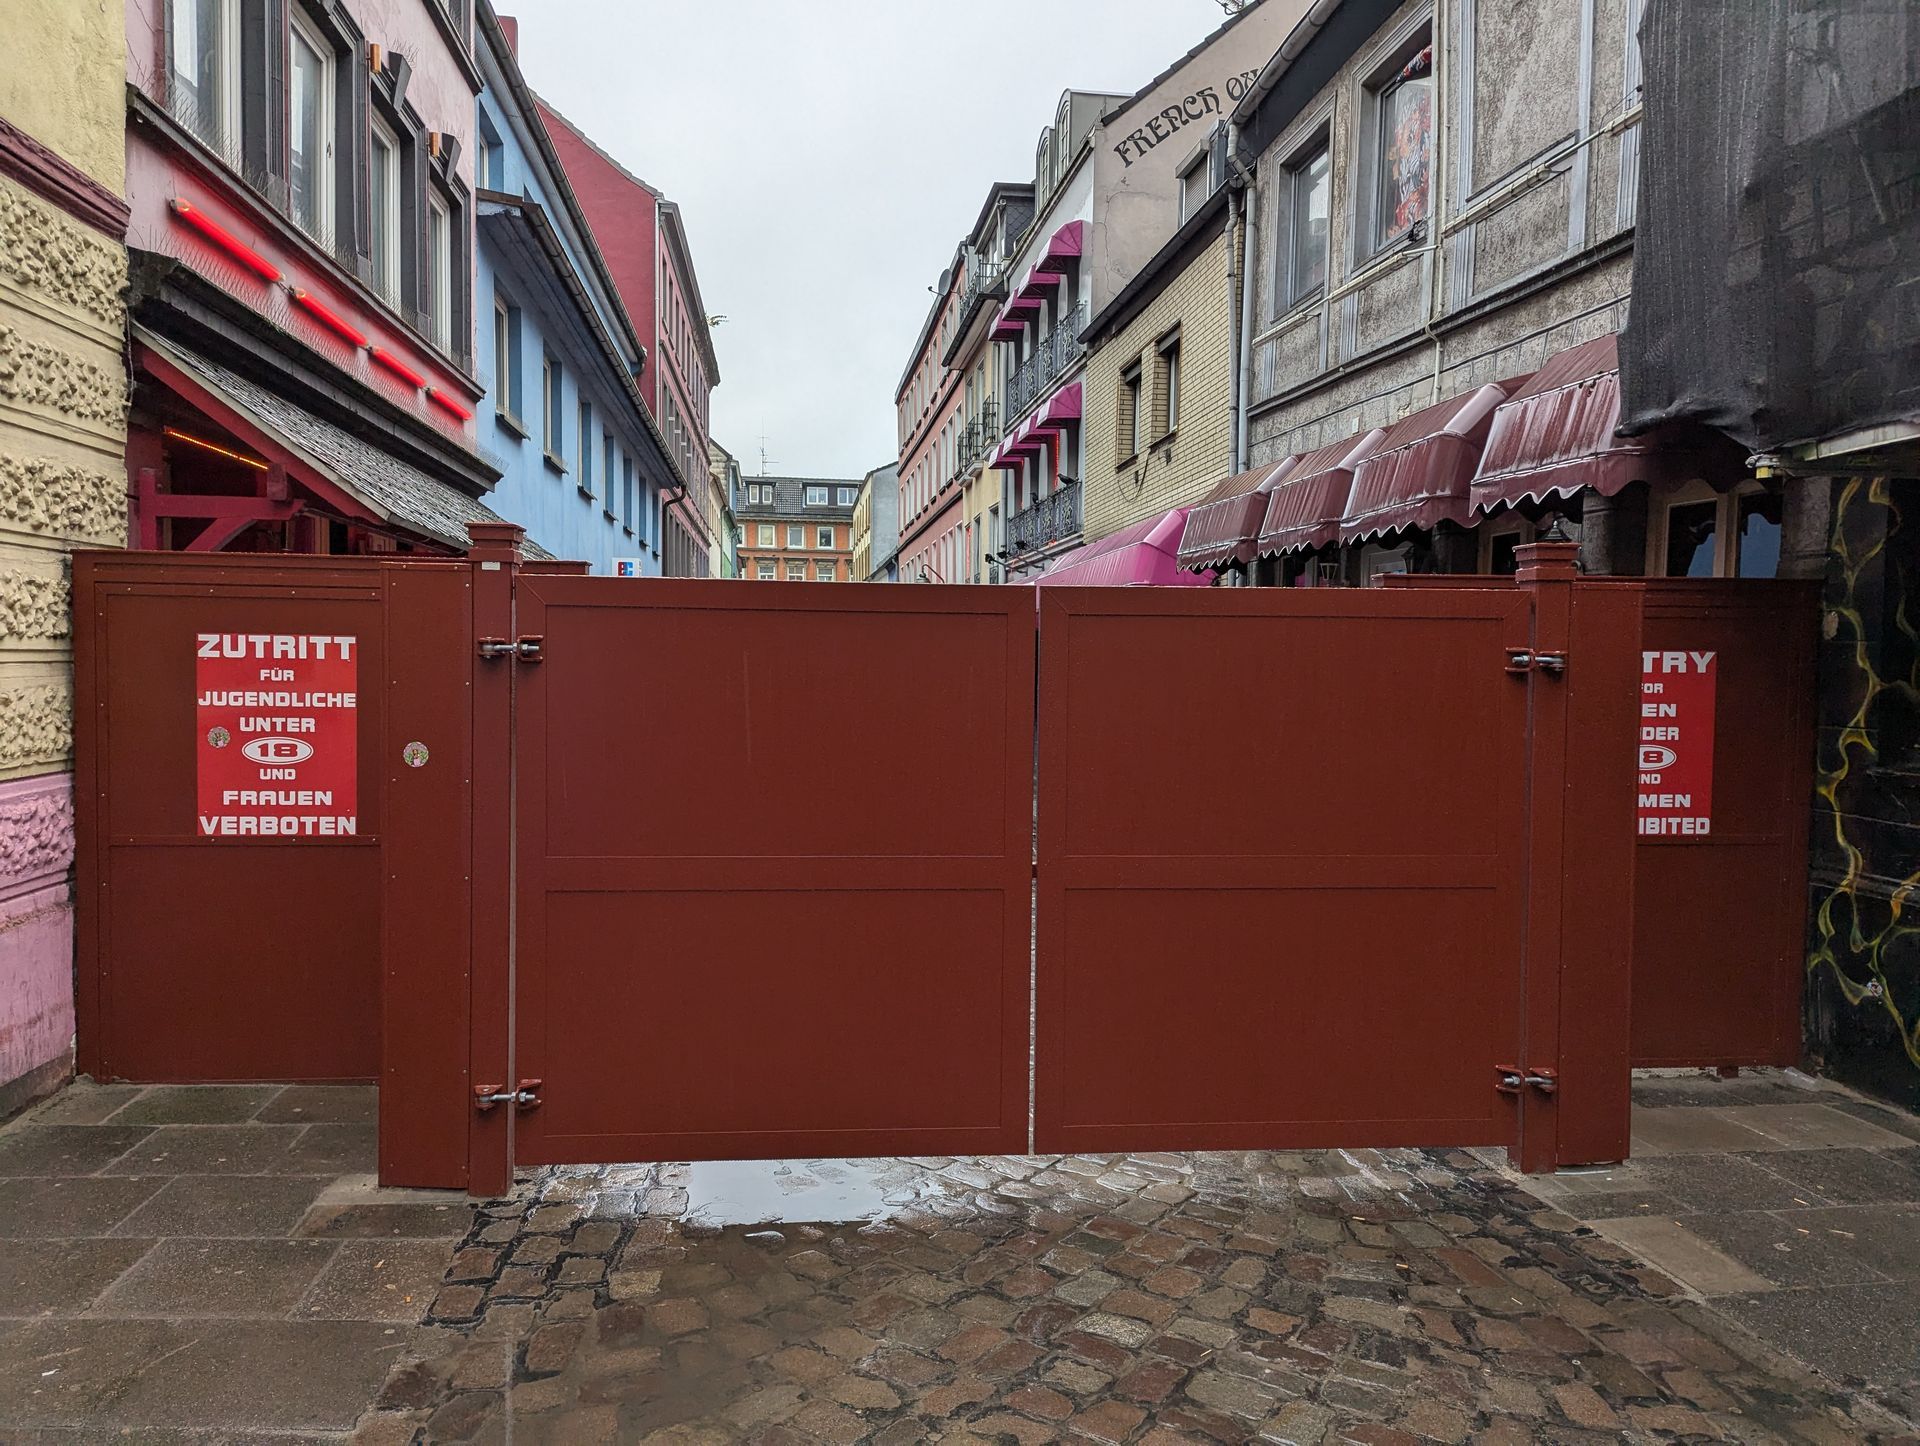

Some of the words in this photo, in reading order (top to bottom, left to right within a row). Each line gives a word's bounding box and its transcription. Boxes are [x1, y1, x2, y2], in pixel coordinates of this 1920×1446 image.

[1113, 86, 1223, 168] FRENCH
[197, 633, 357, 660] ZUTRITT
[259, 667, 295, 682] FÜR
[1641, 682, 1664, 694] OR
[198, 691, 357, 708] JUGENDLICHE
[239, 717, 316, 733] UNTER
[1640, 726, 1680, 741] DER
[257, 743, 299, 758] 18
[259, 769, 296, 780] UND
[1638, 773, 1661, 785] ND
[223, 790, 333, 806] FRAUEN
[199, 815, 356, 835] VERBOTEN
